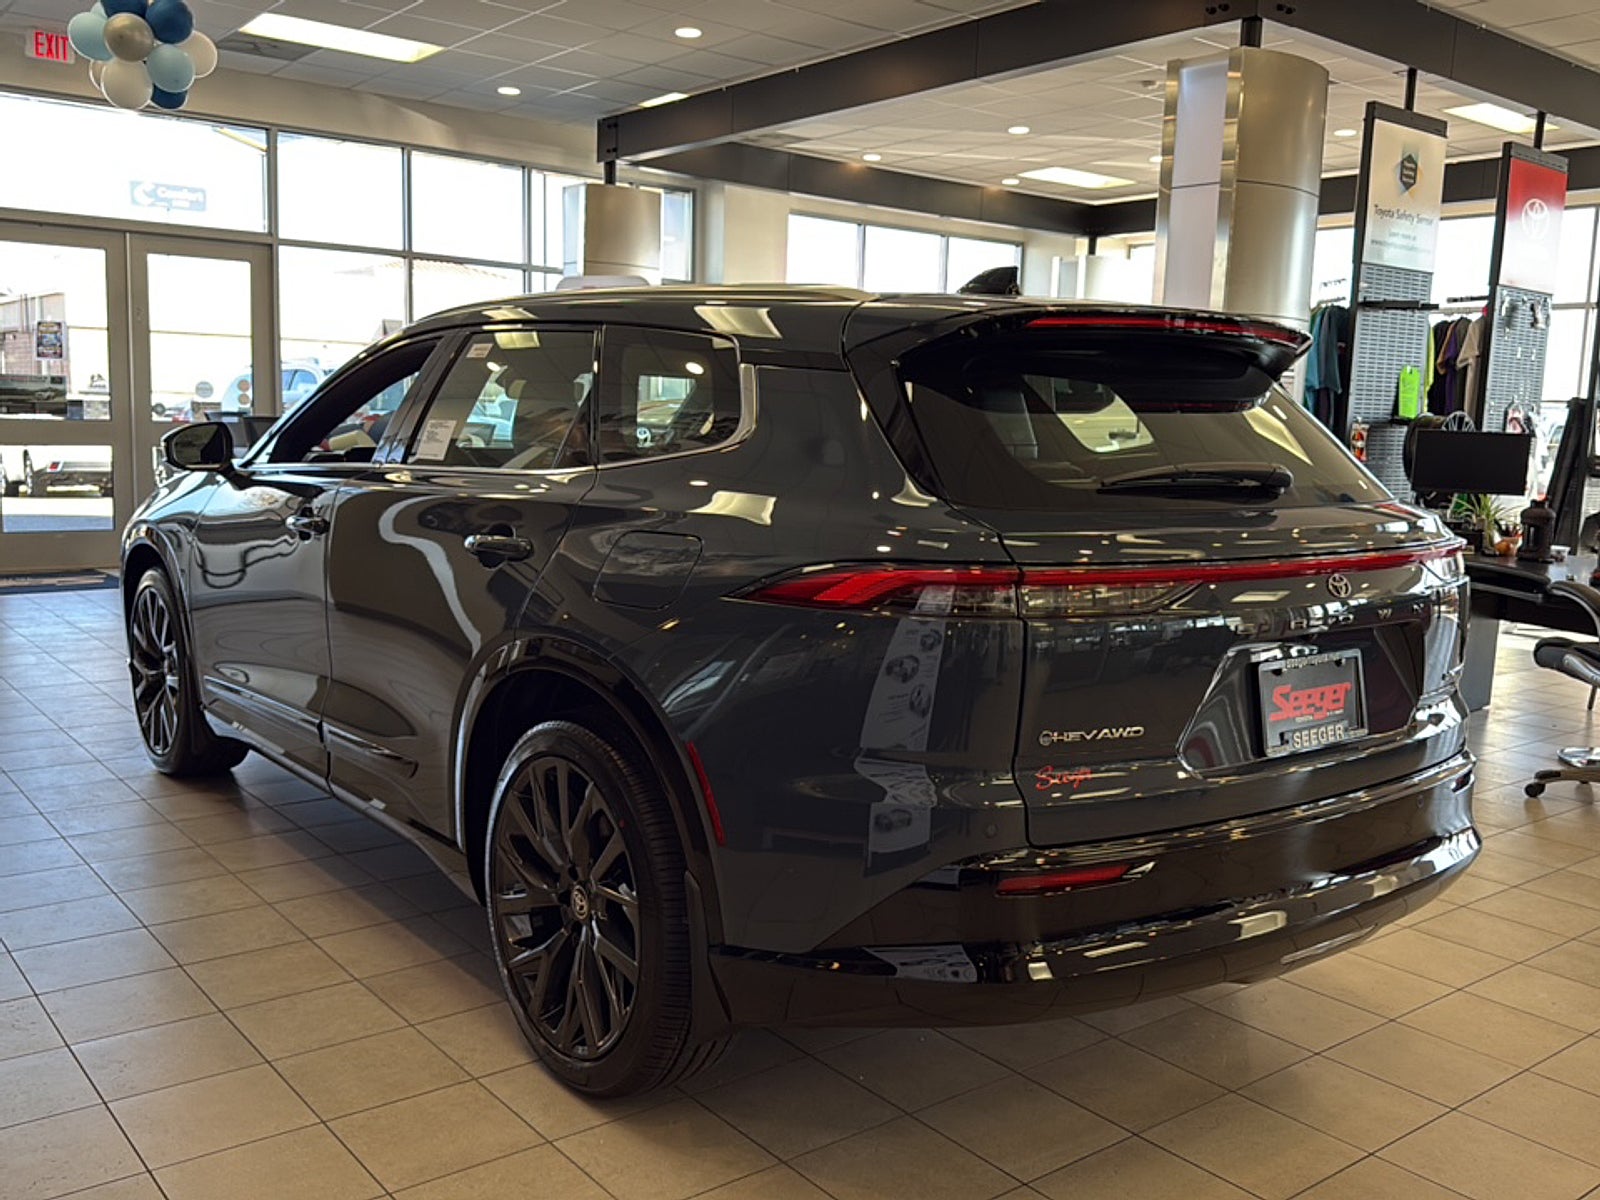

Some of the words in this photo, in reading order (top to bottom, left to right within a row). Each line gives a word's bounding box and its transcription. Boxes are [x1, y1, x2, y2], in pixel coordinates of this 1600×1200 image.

[34, 30, 69, 62] EXIT
[1374, 203, 1395, 219] Toyota
[1269, 682, 1352, 721] Seeger
[1293, 724, 1345, 749] SEEGER
